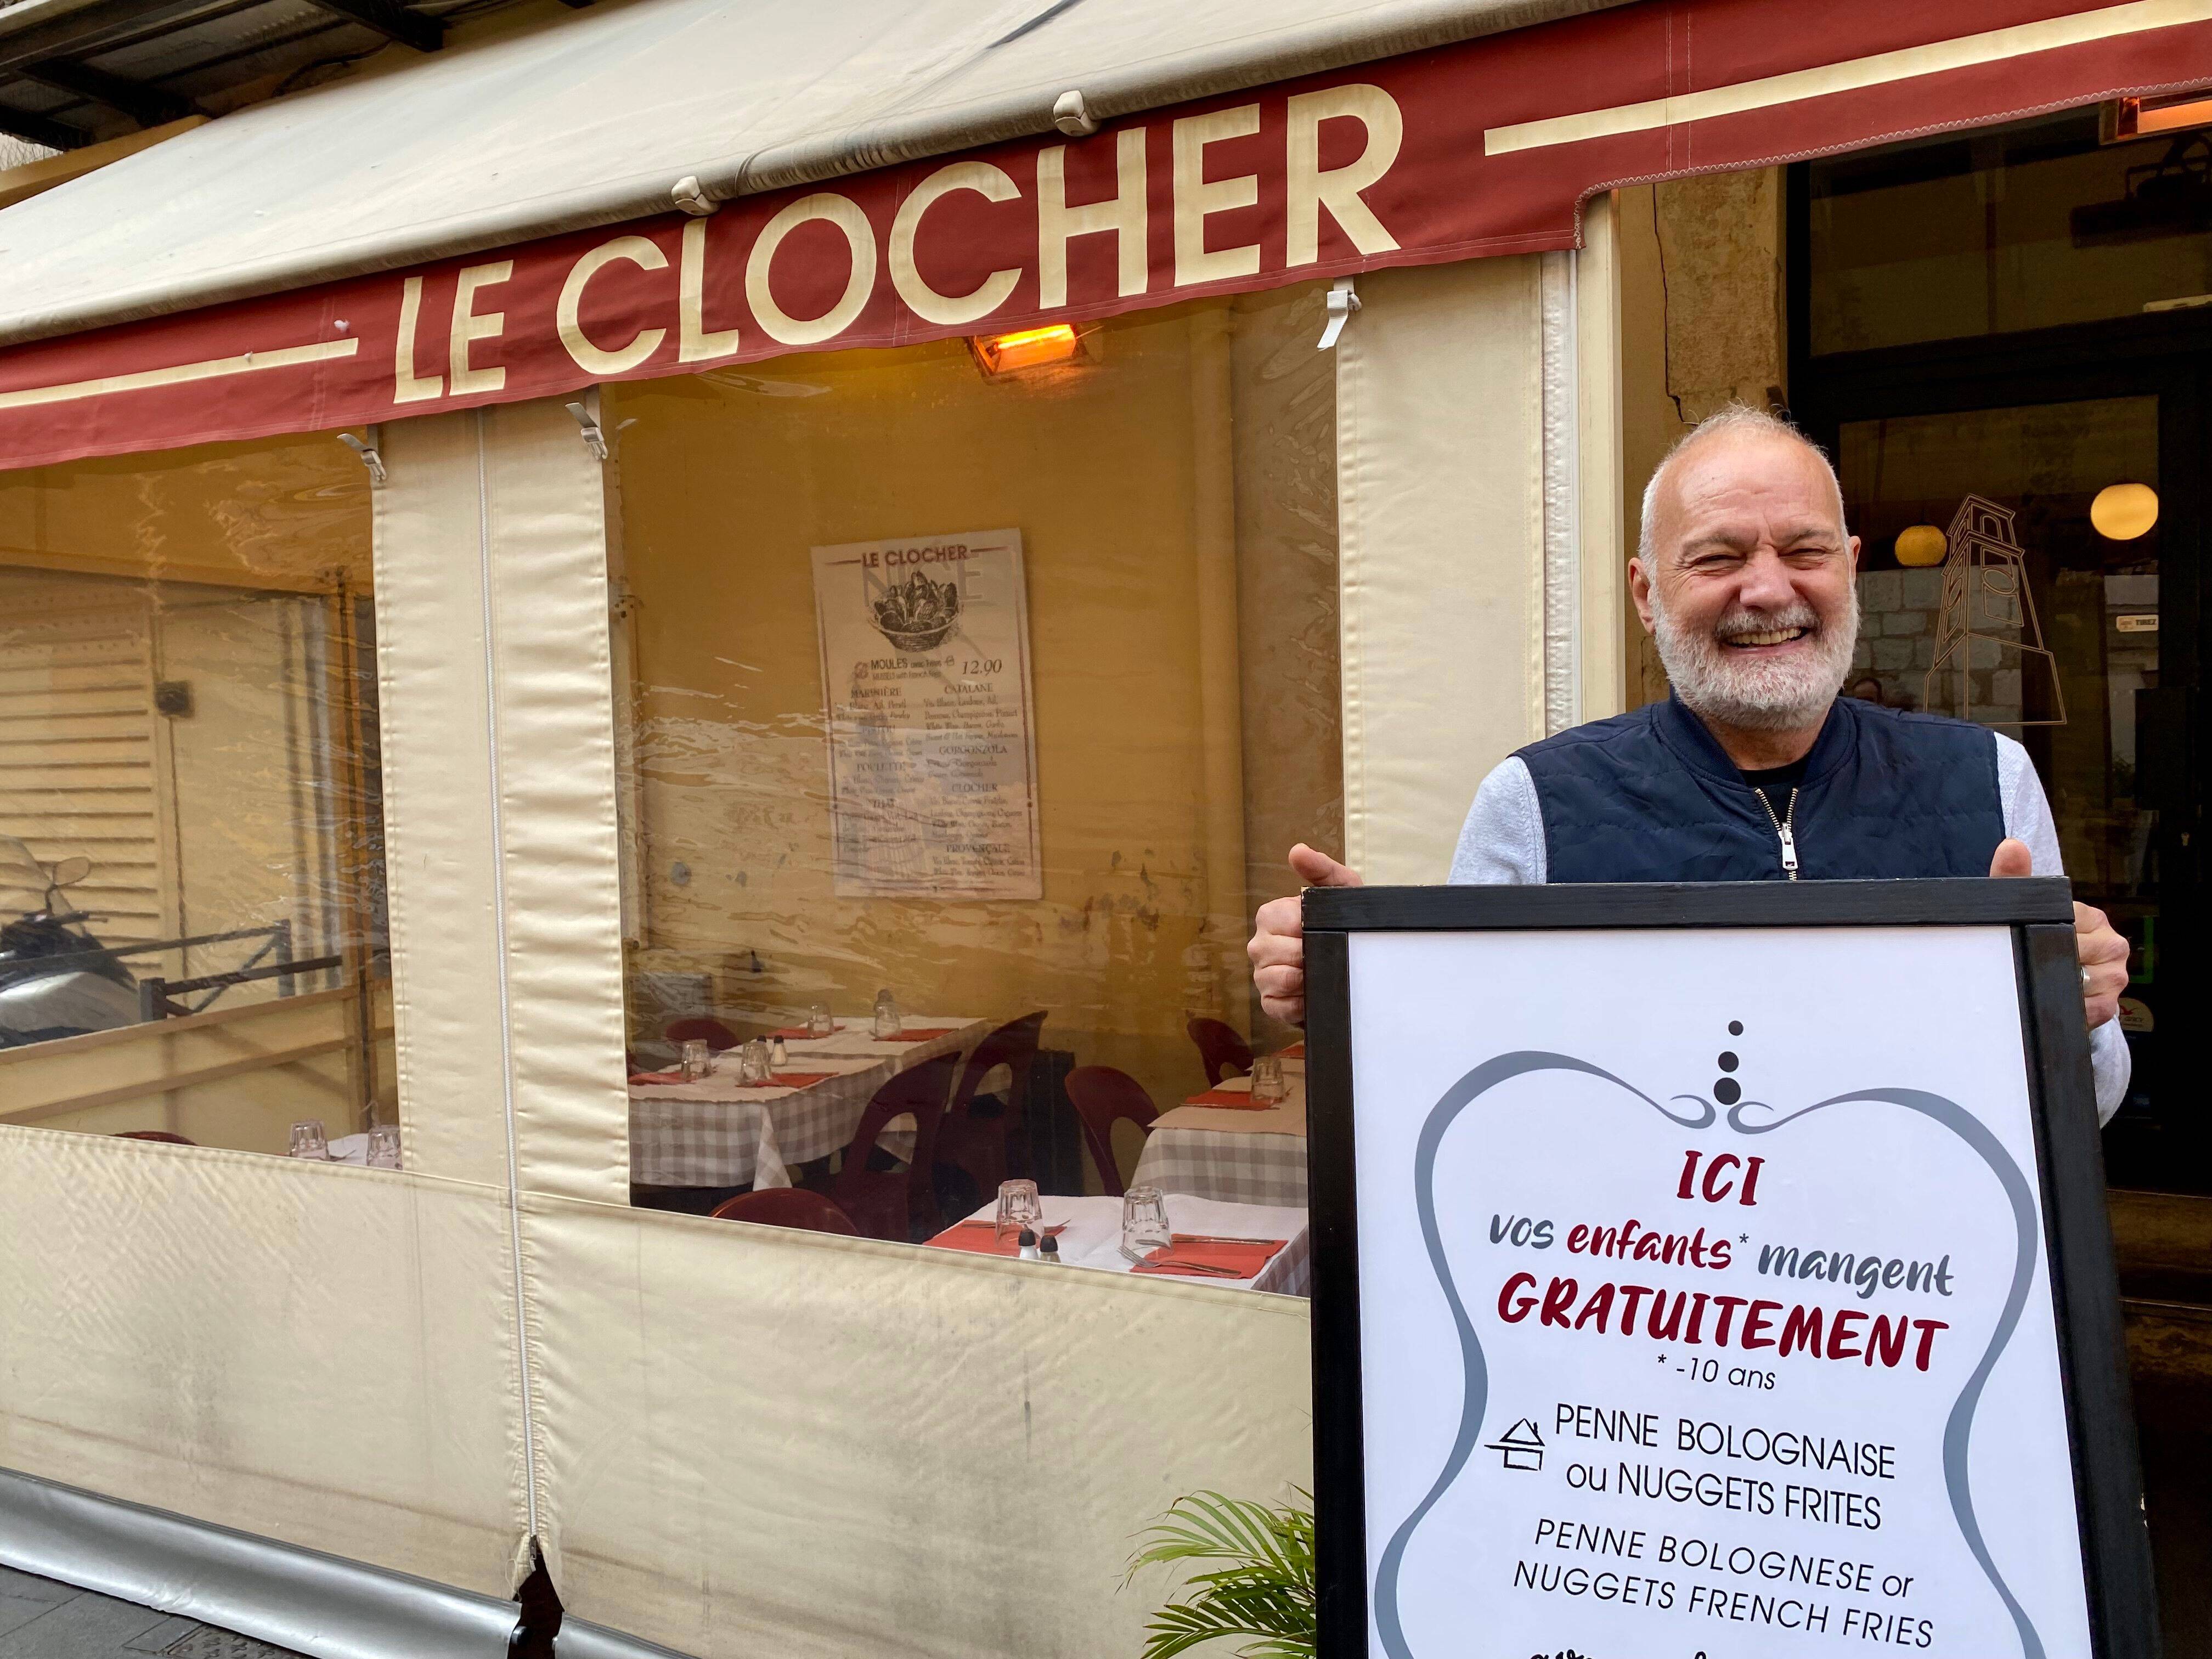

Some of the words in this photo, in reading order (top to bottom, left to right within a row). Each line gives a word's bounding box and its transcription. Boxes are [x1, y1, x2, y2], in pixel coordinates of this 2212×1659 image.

[393, 261, 513, 404] LE
[556, 83, 1403, 376] CLOCHER
[862, 552, 879, 567] LE
[885, 544, 968, 565] CLOCHER
[871, 658, 908, 670] MOULES
[962, 659, 1002, 676] 12.90
[952, 782, 997, 792] CLOCHER
[1677, 1150, 1765, 1206] ICI
[1489, 1214, 1554, 1249] vos
[1758, 1244, 1954, 1299] mangent
[1498, 1272, 1949, 1372] GRATUITEMENT
[1728, 1368, 1776, 1390] ans
[1556, 1403, 1659, 1447] PENNE
[1678, 1418, 1895, 1480] BOLOGNAISE
[1566, 1464, 1607, 1492] ou
[1618, 1462, 1774, 1515] NUGGETS
[1785, 1485, 1881, 1530] FRITES
[1535, 1518, 1646, 1559] PENNE
[1658, 1535, 1874, 1592] BOLOGNESE
[1882, 1575, 1914, 1598] or
[1514, 1560, 1675, 1609] NUGGETS
[1689, 1585, 1829, 1633] FRENCH
[1843, 1608, 1933, 1648] FRIES
